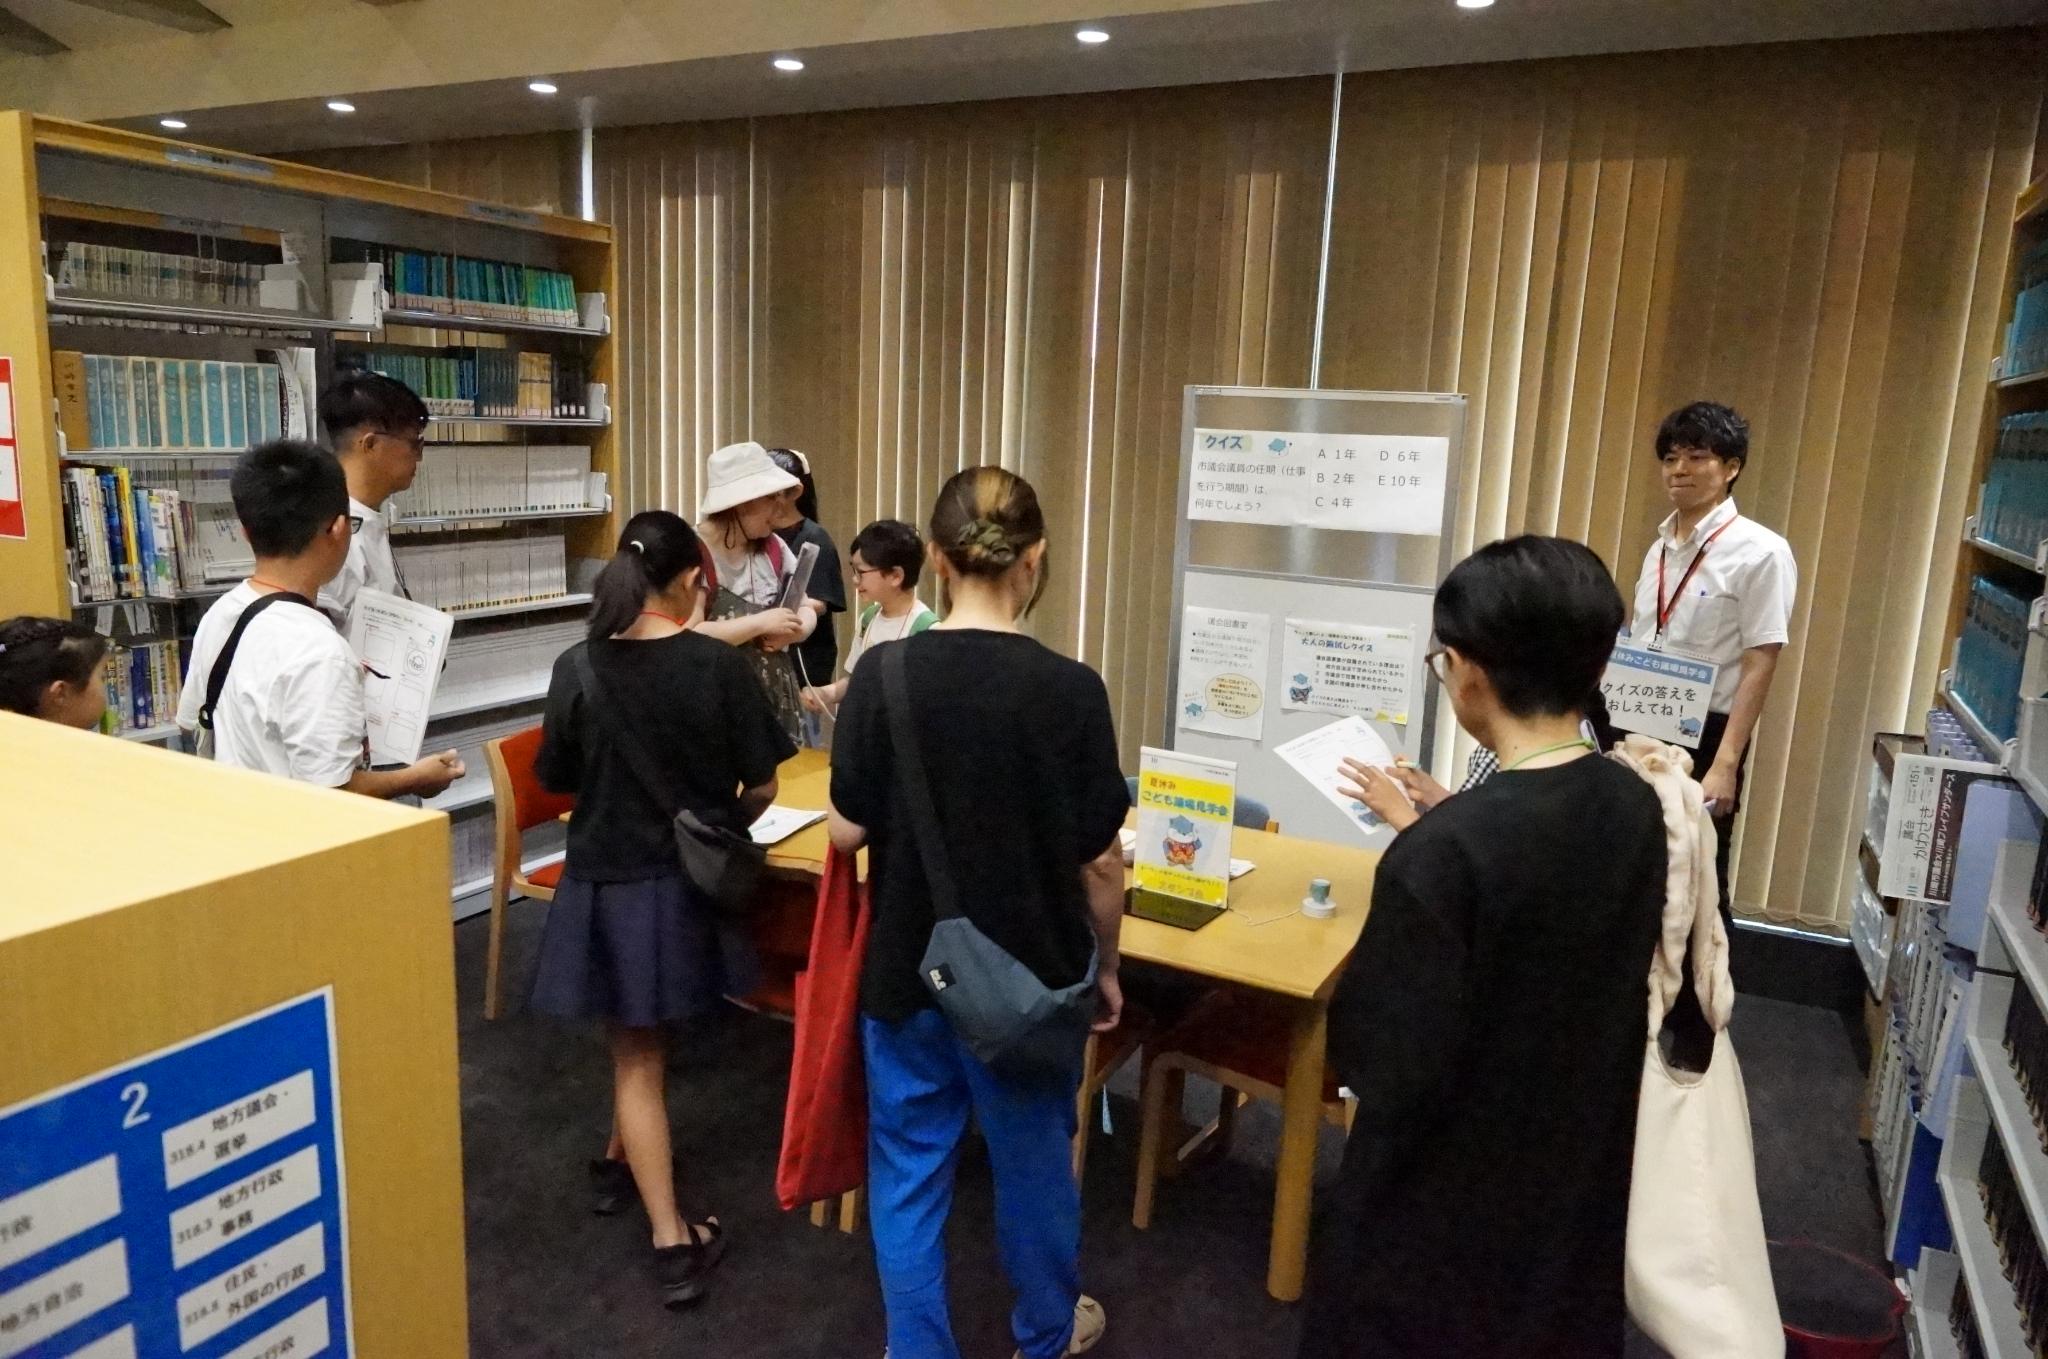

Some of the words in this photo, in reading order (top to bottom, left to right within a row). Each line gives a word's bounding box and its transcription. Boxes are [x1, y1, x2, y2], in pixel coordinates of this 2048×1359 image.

[1205, 434, 1243, 450] クイズ
[1318, 449, 1326, 459] A
[1335, 449, 1357, 461] 1年
[1380, 451, 1388, 461] D
[1398, 451, 1421, 462] 6年
[1316, 473, 1324, 483] B
[1333, 473, 1355, 485] 2年
[1378, 475, 1385, 485] E
[1315, 497, 1323, 507] C
[1331, 497, 1353, 509] 4年
[1613, 651, 1708, 679] 休みこども議場見学会
[1603, 682, 1697, 702] クイズの答えを
[1607, 700, 1684, 717] おしえてね！
[1913, 805, 1934, 861] かわさき
[120, 1081, 151, 1130] 2
